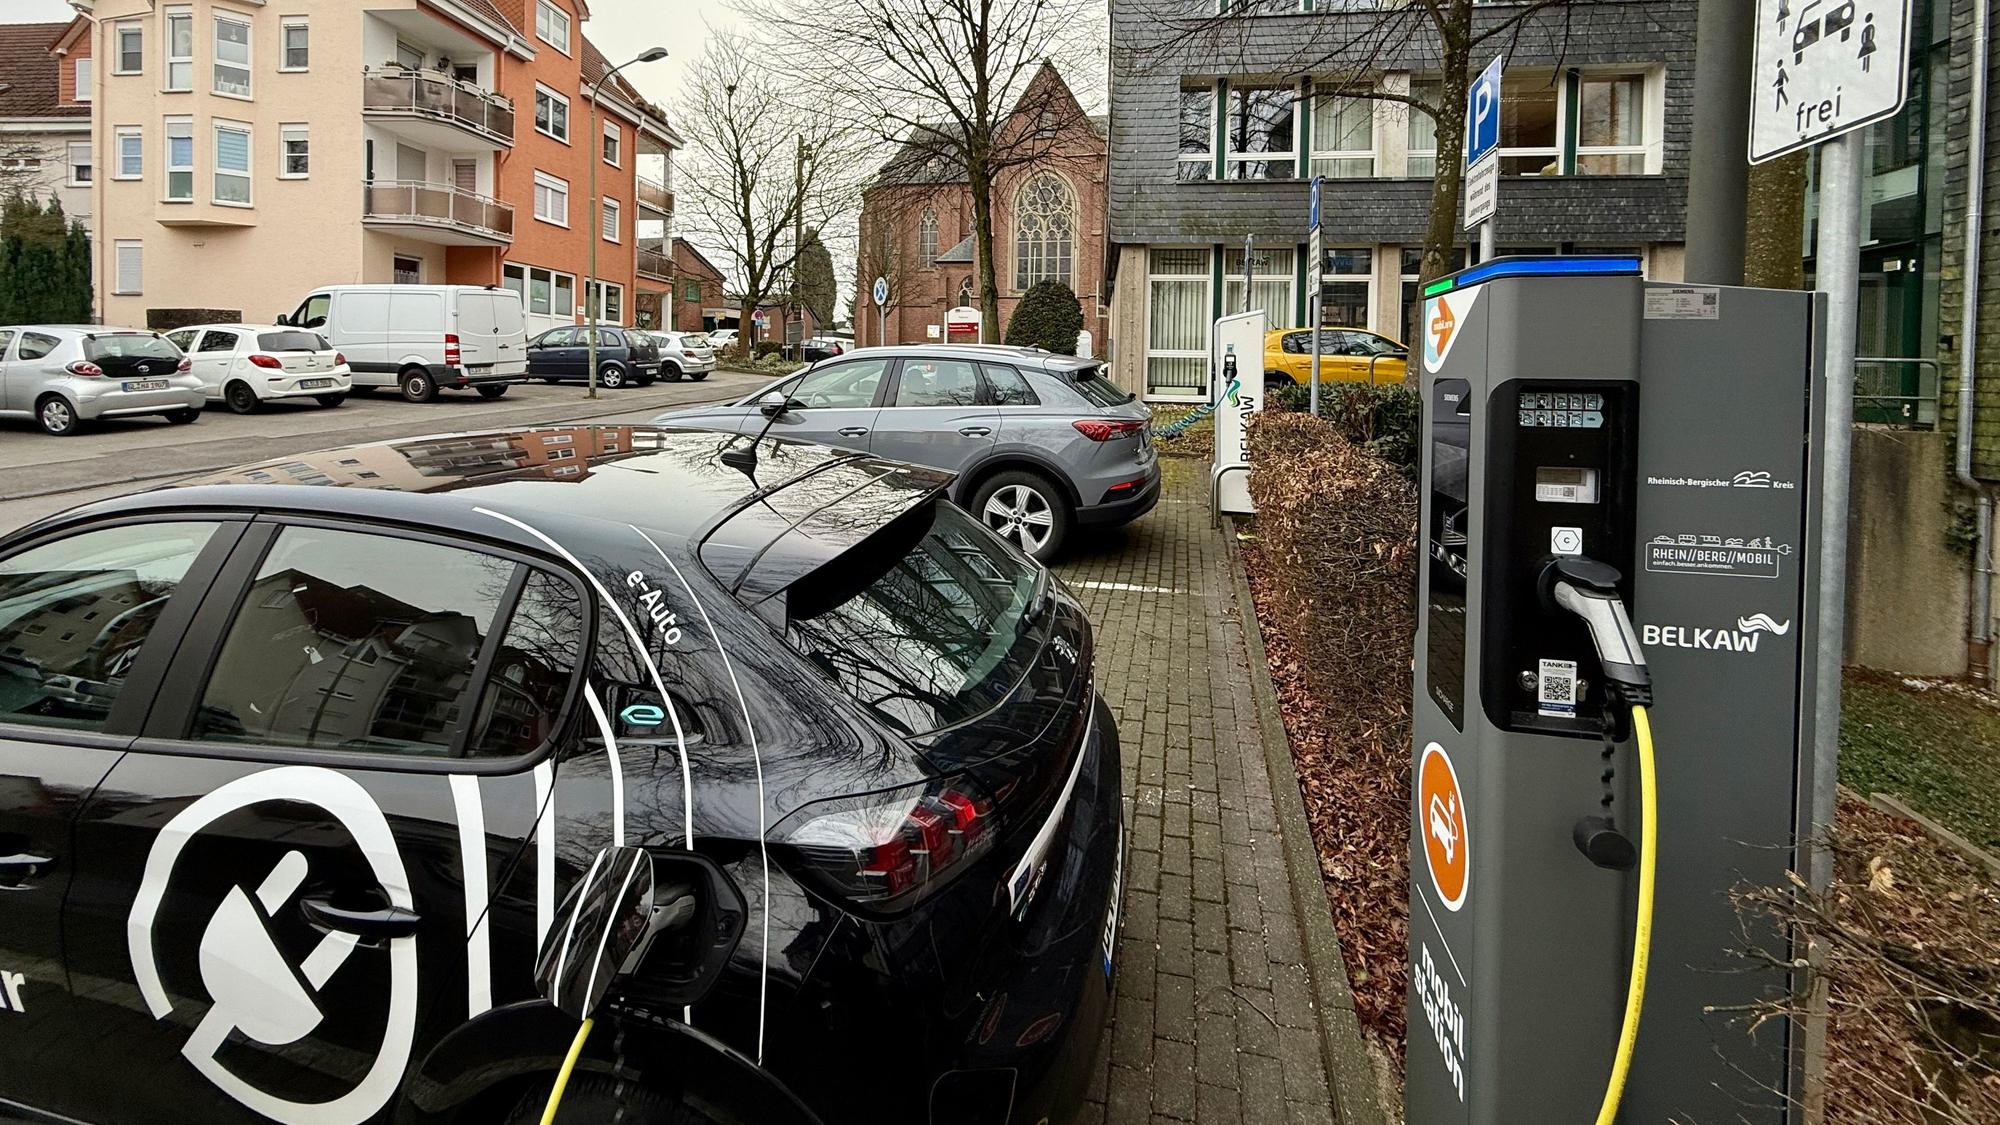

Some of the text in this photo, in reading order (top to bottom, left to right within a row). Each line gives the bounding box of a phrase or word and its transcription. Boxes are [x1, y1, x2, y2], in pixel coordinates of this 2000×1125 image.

[1474, 81, 1492, 150] P
[1796, 86, 1841, 132] frei
[1311, 185, 1317, 224] P
[1647, 476, 1795, 489] Rheinisch-Bergischer Kreis
[1652, 548, 1774, 565] RHEIN//BERG//MOBIL
[626, 570, 682, 645] e-Auto
[1642, 624, 1760, 653] BELKAW
[0, 968, 26, 1013] r
[1422, 941, 1465, 1062] mobil
[1414, 962, 1464, 1103] station
